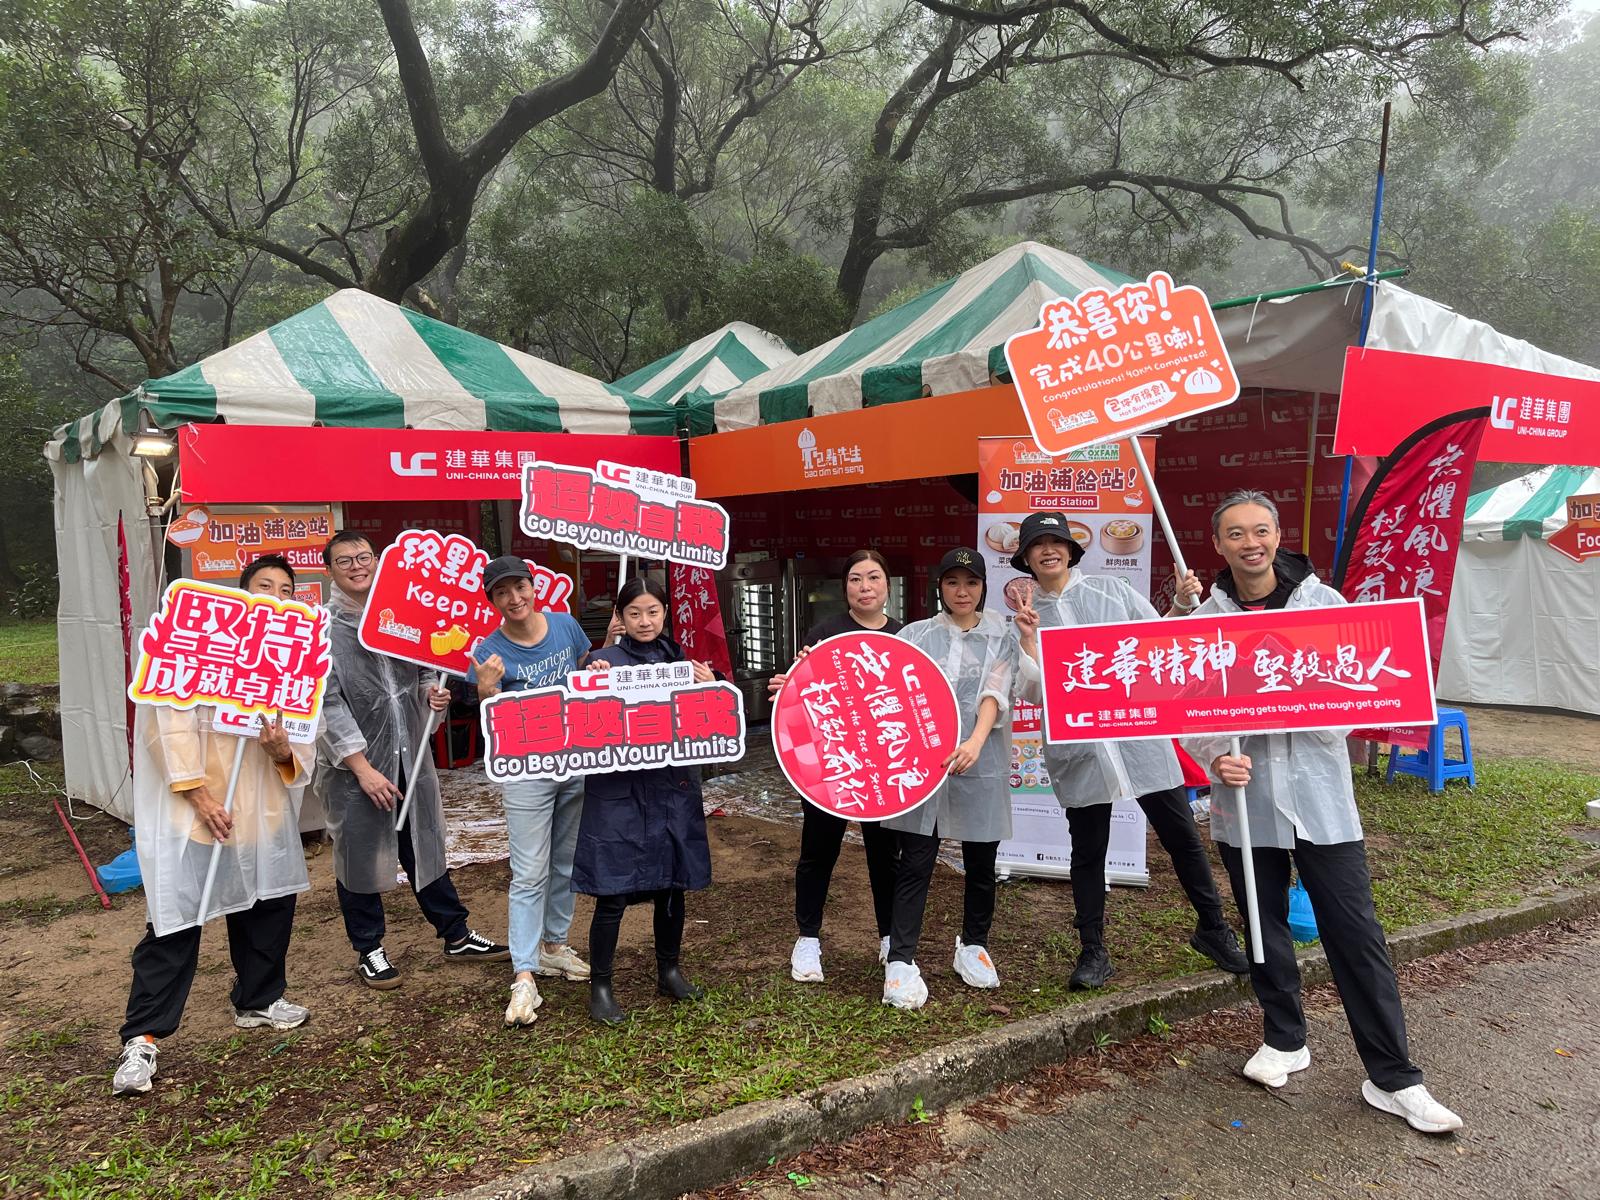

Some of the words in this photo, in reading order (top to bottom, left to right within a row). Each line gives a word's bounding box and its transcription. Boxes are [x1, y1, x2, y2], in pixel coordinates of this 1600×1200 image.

[1047, 279, 1172, 350] 恭喜你!
[1030, 315, 1205, 390] 完成40公里喇!
[1043, 373, 1125, 404] Congratulations!
[1154, 350, 1208, 371] Completed!
[1520, 396, 1572, 424] 建華集團
[1517, 426, 1546, 436] UNI-CHINA
[1546, 429, 1568, 438] GROUP
[446, 450, 536, 468] 建華集團
[832, 466, 844, 475] sin
[844, 464, 864, 474] seng
[446, 472, 500, 480] UNI-CHINA
[502, 472, 522, 480] GRO
[635, 470, 693, 493] 建華集團
[1000, 467, 1137, 492] 加油補給站!
[635, 484, 668, 495] UNI-CHINA
[670, 490, 692, 500] GROUP
[1034, 497, 1058, 506] Food
[1060, 497, 1094, 506] Station
[529, 468, 724, 550] 超越自我
[208, 516, 329, 546] 加油補給站
[526, 514, 550, 532] Go
[556, 520, 624, 546] Beyond
[628, 534, 670, 554] Your
[672, 541, 722, 565] Limits
[288, 548, 324, 565] Statio
[406, 581, 468, 619] Keep
[474, 602, 494, 625] it
[163, 589, 314, 675] 堅持
[516, 646, 572, 680] American
[524, 662, 570, 690] Eagle
[616, 666, 690, 684] 建華集團
[832, 648, 849, 692] Fearless
[1061, 626, 1236, 699] 建華精神
[1254, 644, 1412, 694] 堅毅過人
[142, 654, 316, 714] 成就卓越
[616, 682, 660, 692] UNI-CHINA
[662, 680, 690, 688] GROUP
[845, 696, 854, 707] in
[1098, 706, 1157, 721] 建華集團
[1186, 708, 1212, 718] When
[1213, 707, 1228, 716] the
[1230, 705, 1255, 717] going
[1256, 704, 1276, 716] gets
[1278, 702, 1308, 714] tough,
[1309, 701, 1325, 710] the
[1326, 700, 1354, 711] tough
[1356, 699, 1372, 710] get
[1374, 697, 1401, 708] going
[490, 687, 738, 756] 超越自我
[850, 710, 860, 728] the
[915, 692, 942, 748] 建華集團
[494, 757, 524, 775] Go
[527, 746, 610, 773] Beyond
[616, 744, 667, 764] Your
[673, 736, 738, 758] Limits
[865, 758, 877, 769] of
[870, 772, 886, 806] Storms
